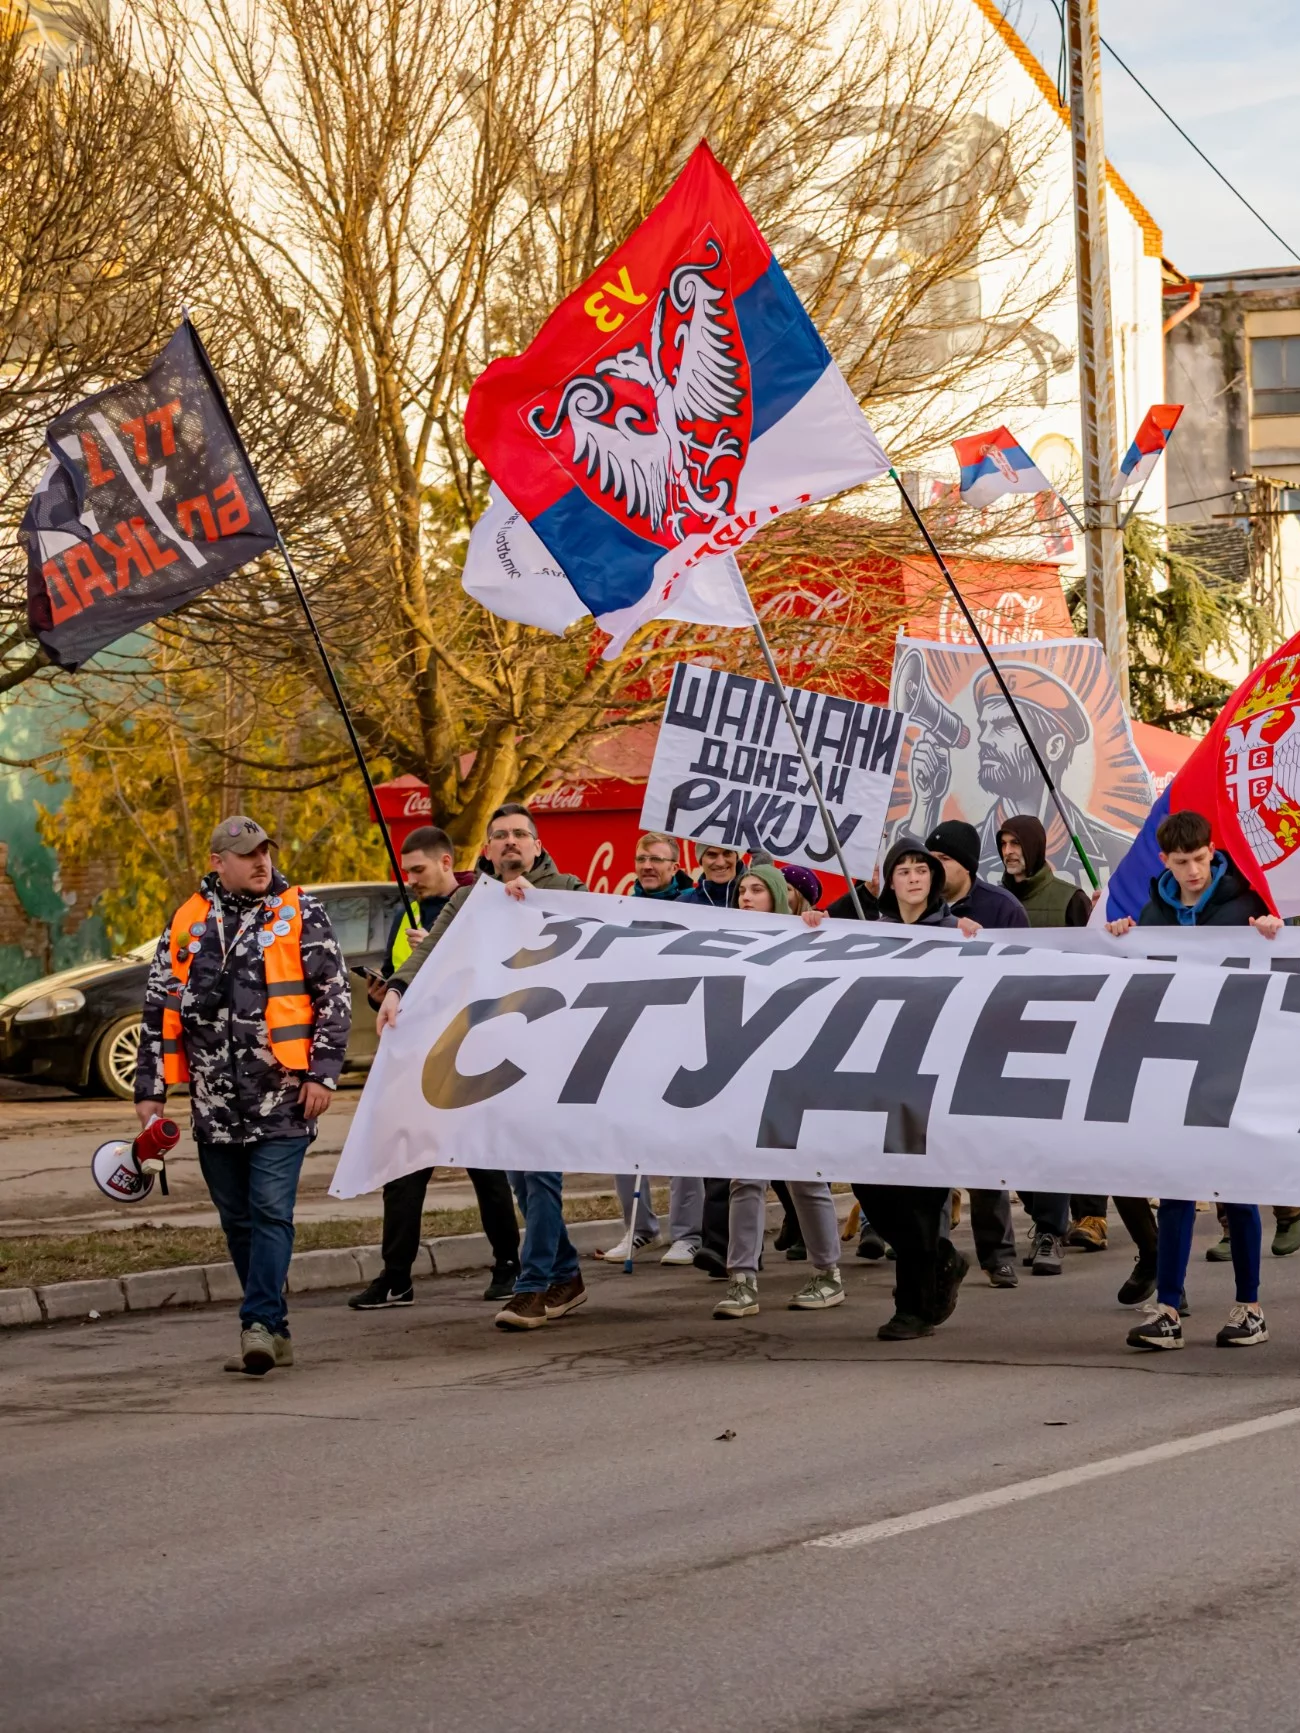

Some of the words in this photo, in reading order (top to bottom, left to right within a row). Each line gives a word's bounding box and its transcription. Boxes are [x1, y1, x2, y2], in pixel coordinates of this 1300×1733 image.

[666, 662, 904, 775] ШАПЧАНИ
[689, 737, 851, 805] ДОНЕЛИ
[665, 777, 862, 863] РАКИЈУ
